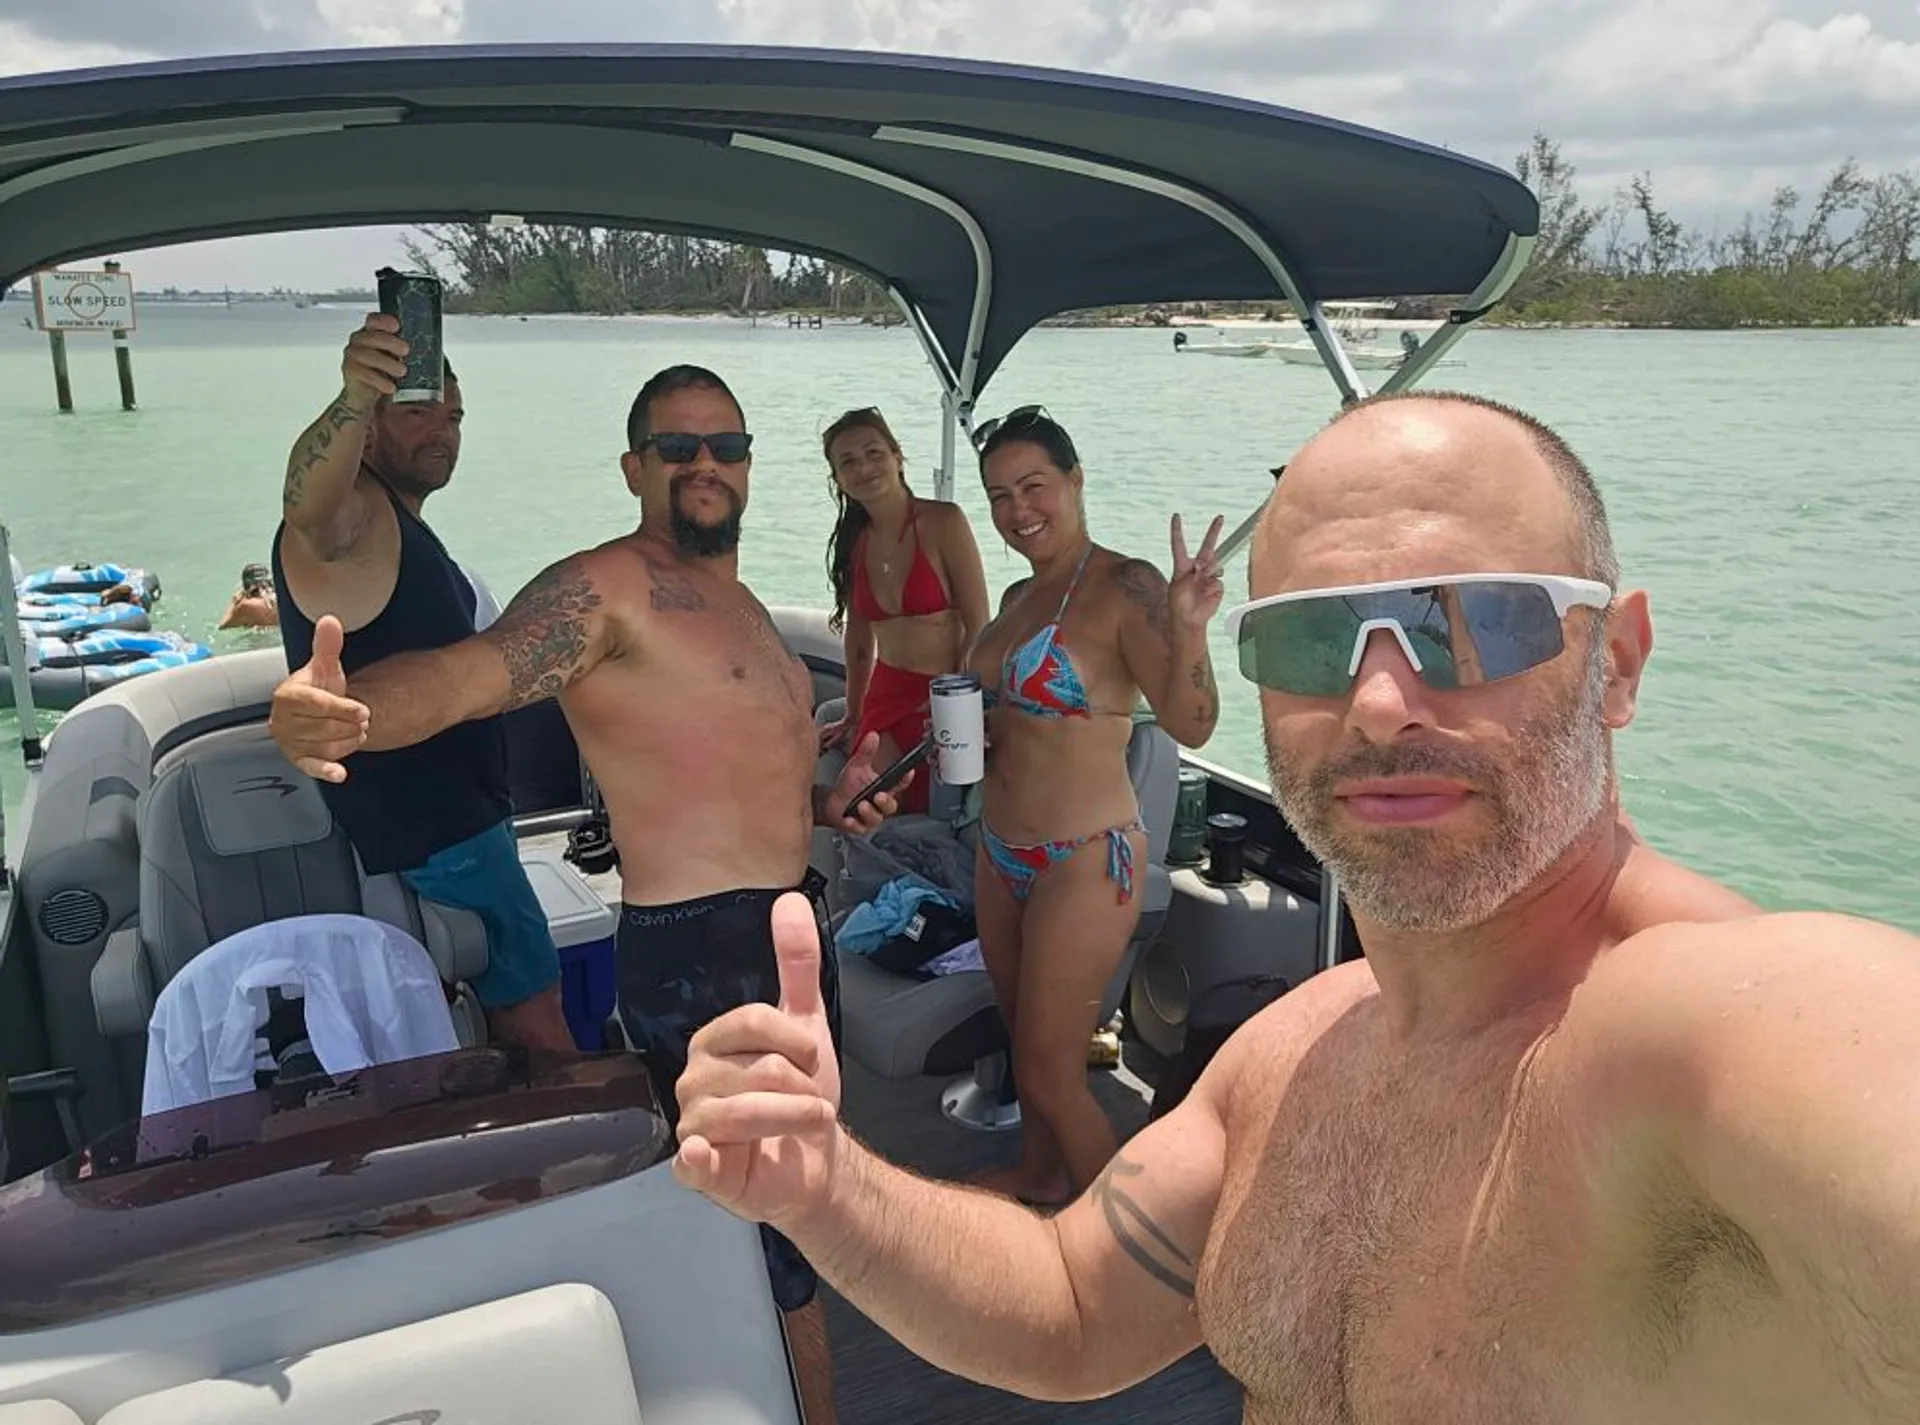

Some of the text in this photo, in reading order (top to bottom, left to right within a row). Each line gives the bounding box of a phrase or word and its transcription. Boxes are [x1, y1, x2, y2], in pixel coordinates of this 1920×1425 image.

[47, 295, 127, 307] SLOW SPEED
[629, 910, 673, 927] Calvin
